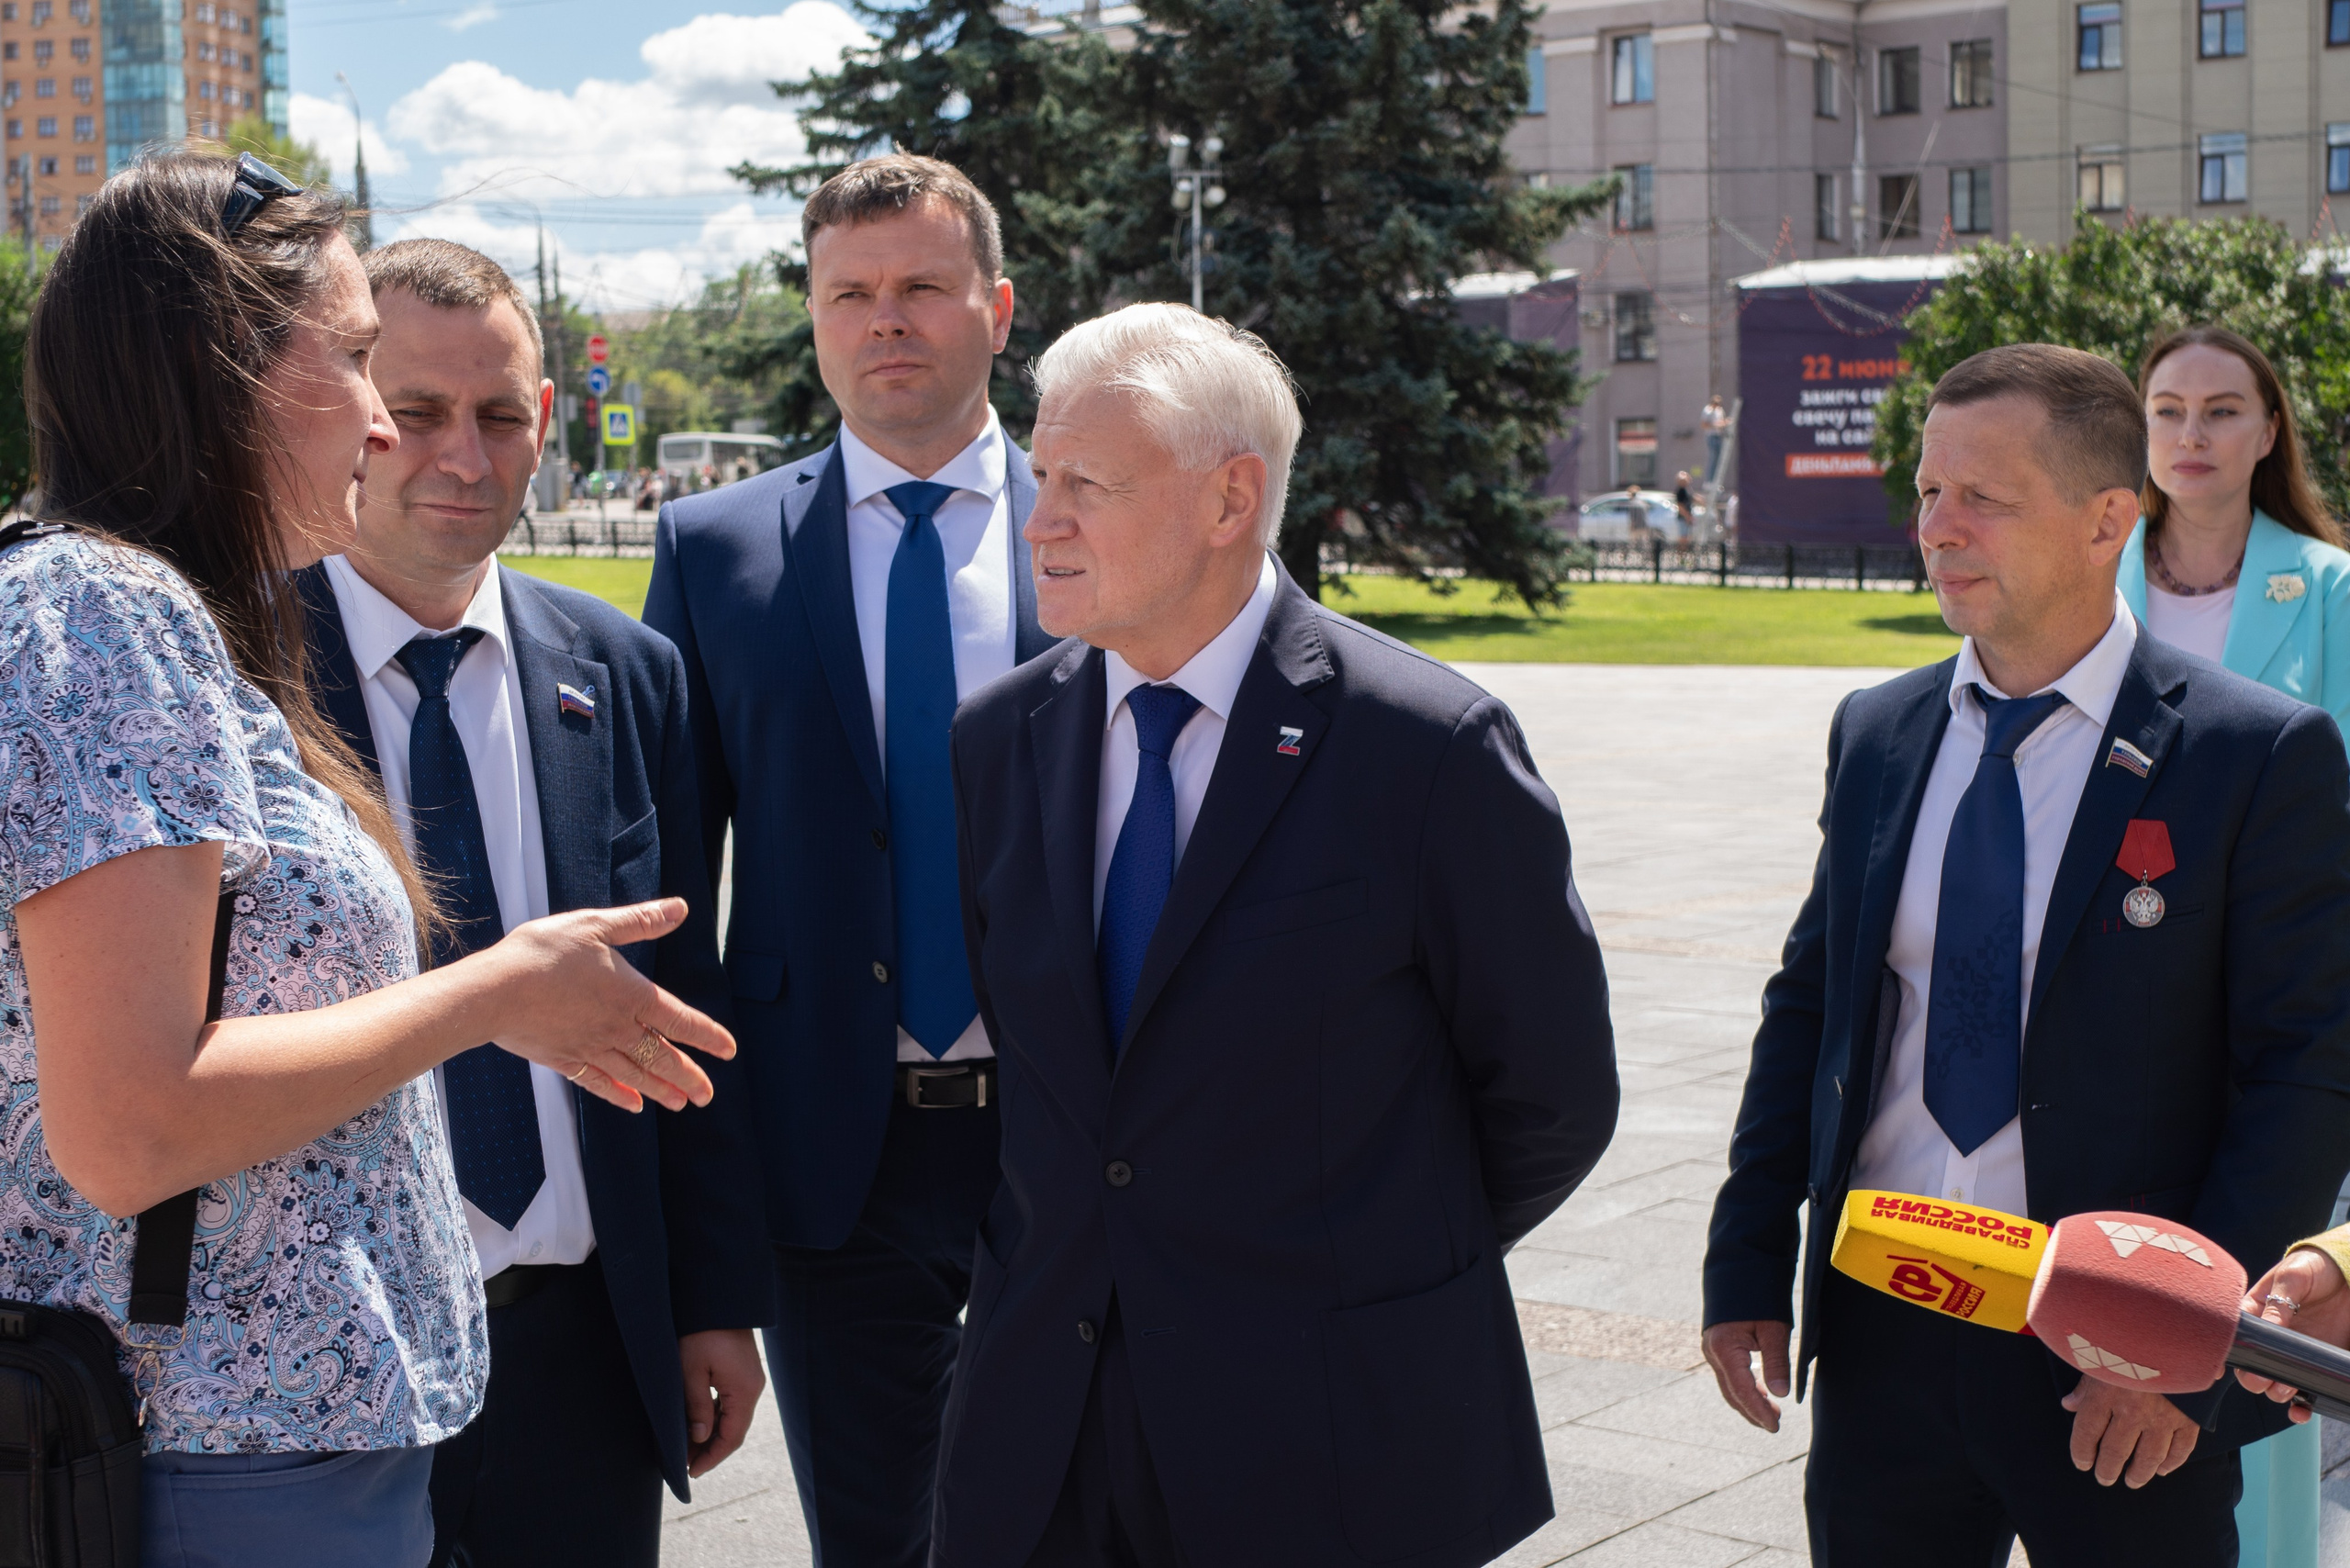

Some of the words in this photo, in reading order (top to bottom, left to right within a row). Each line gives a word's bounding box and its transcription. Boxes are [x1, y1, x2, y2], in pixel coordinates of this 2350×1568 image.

[1801, 354, 1832, 380] 22
[1277, 726, 1304, 756] Z
[1871, 1208, 2031, 1249] СПРАВЕДЛИВАЯ
[1874, 1196, 2032, 1240] РОССИЯ
